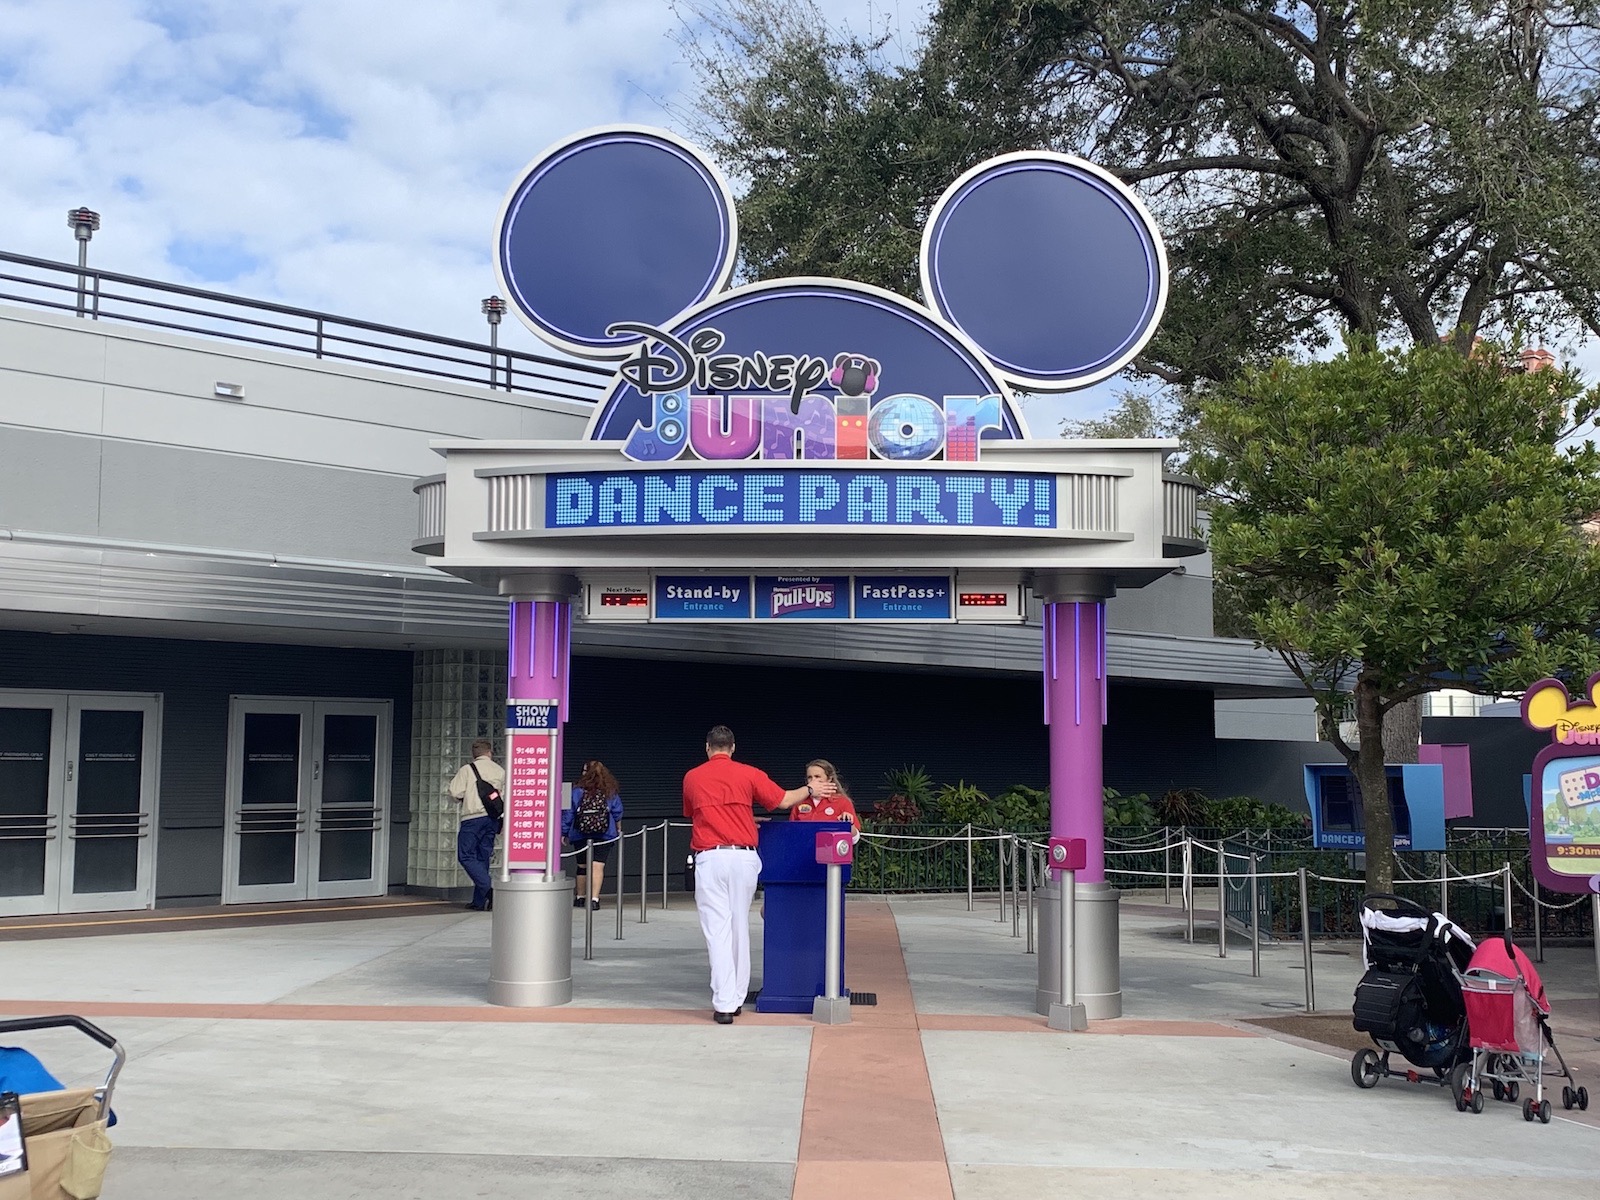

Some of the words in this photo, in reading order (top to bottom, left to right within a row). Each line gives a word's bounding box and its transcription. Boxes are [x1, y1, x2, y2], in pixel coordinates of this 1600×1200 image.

[606, 322, 827, 415] Disney
[620, 387, 1002, 461] Junior
[556, 474, 784, 525] DANCE
[799, 474, 1050, 526] PARTY!
[666, 585, 740, 602] Stand-by
[862, 585, 945, 599] FastPass+
[683, 602, 724, 610] Entrance
[882, 602, 922, 611] Entrance
[515, 706, 550, 716] SHOW
[516, 716, 548, 727] TIMES
[1321, 834, 1354, 844] DANCE
